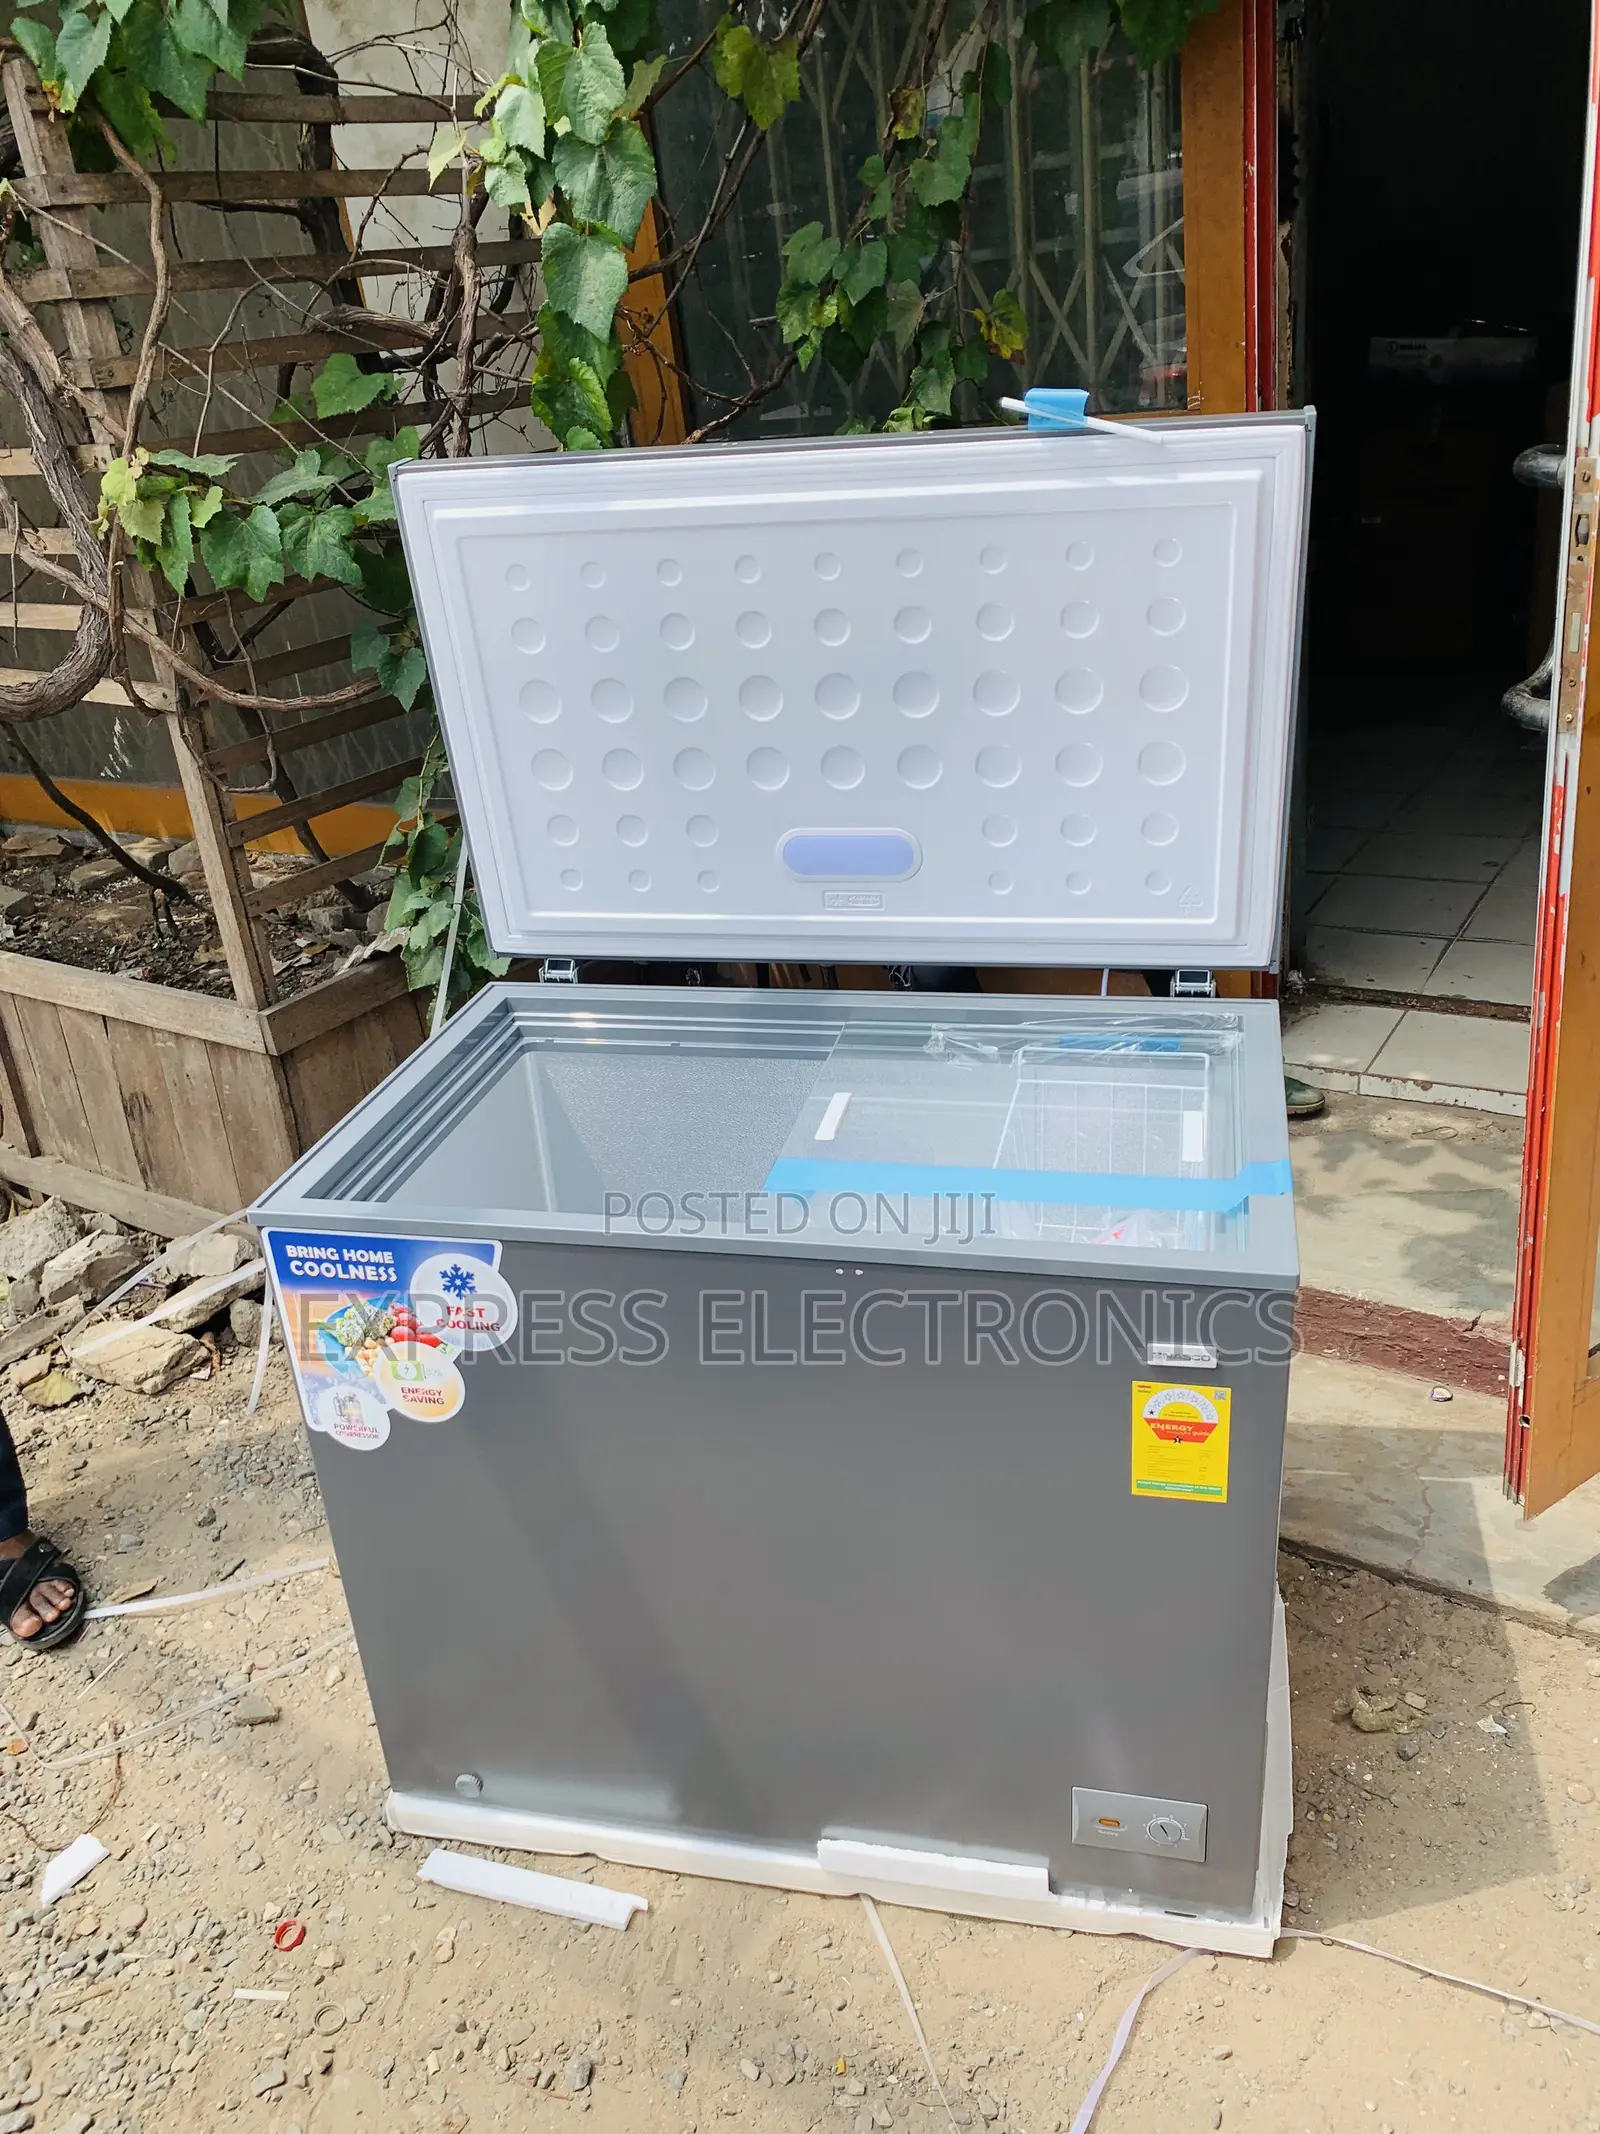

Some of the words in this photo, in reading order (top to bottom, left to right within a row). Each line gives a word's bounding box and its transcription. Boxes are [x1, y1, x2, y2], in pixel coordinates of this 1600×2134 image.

[285, 1244, 339, 1261] BRING
[343, 1249, 395, 1264] HOME
[289, 1260, 398, 1283] COOLNESS
[446, 1306, 485, 1318] FAST
[436, 1319, 501, 1332] COOLING
[401, 1387, 442, 1397] ENERGY
[402, 1395, 445, 1405] SAVING
[1150, 1422, 1194, 1432] ENERGY
